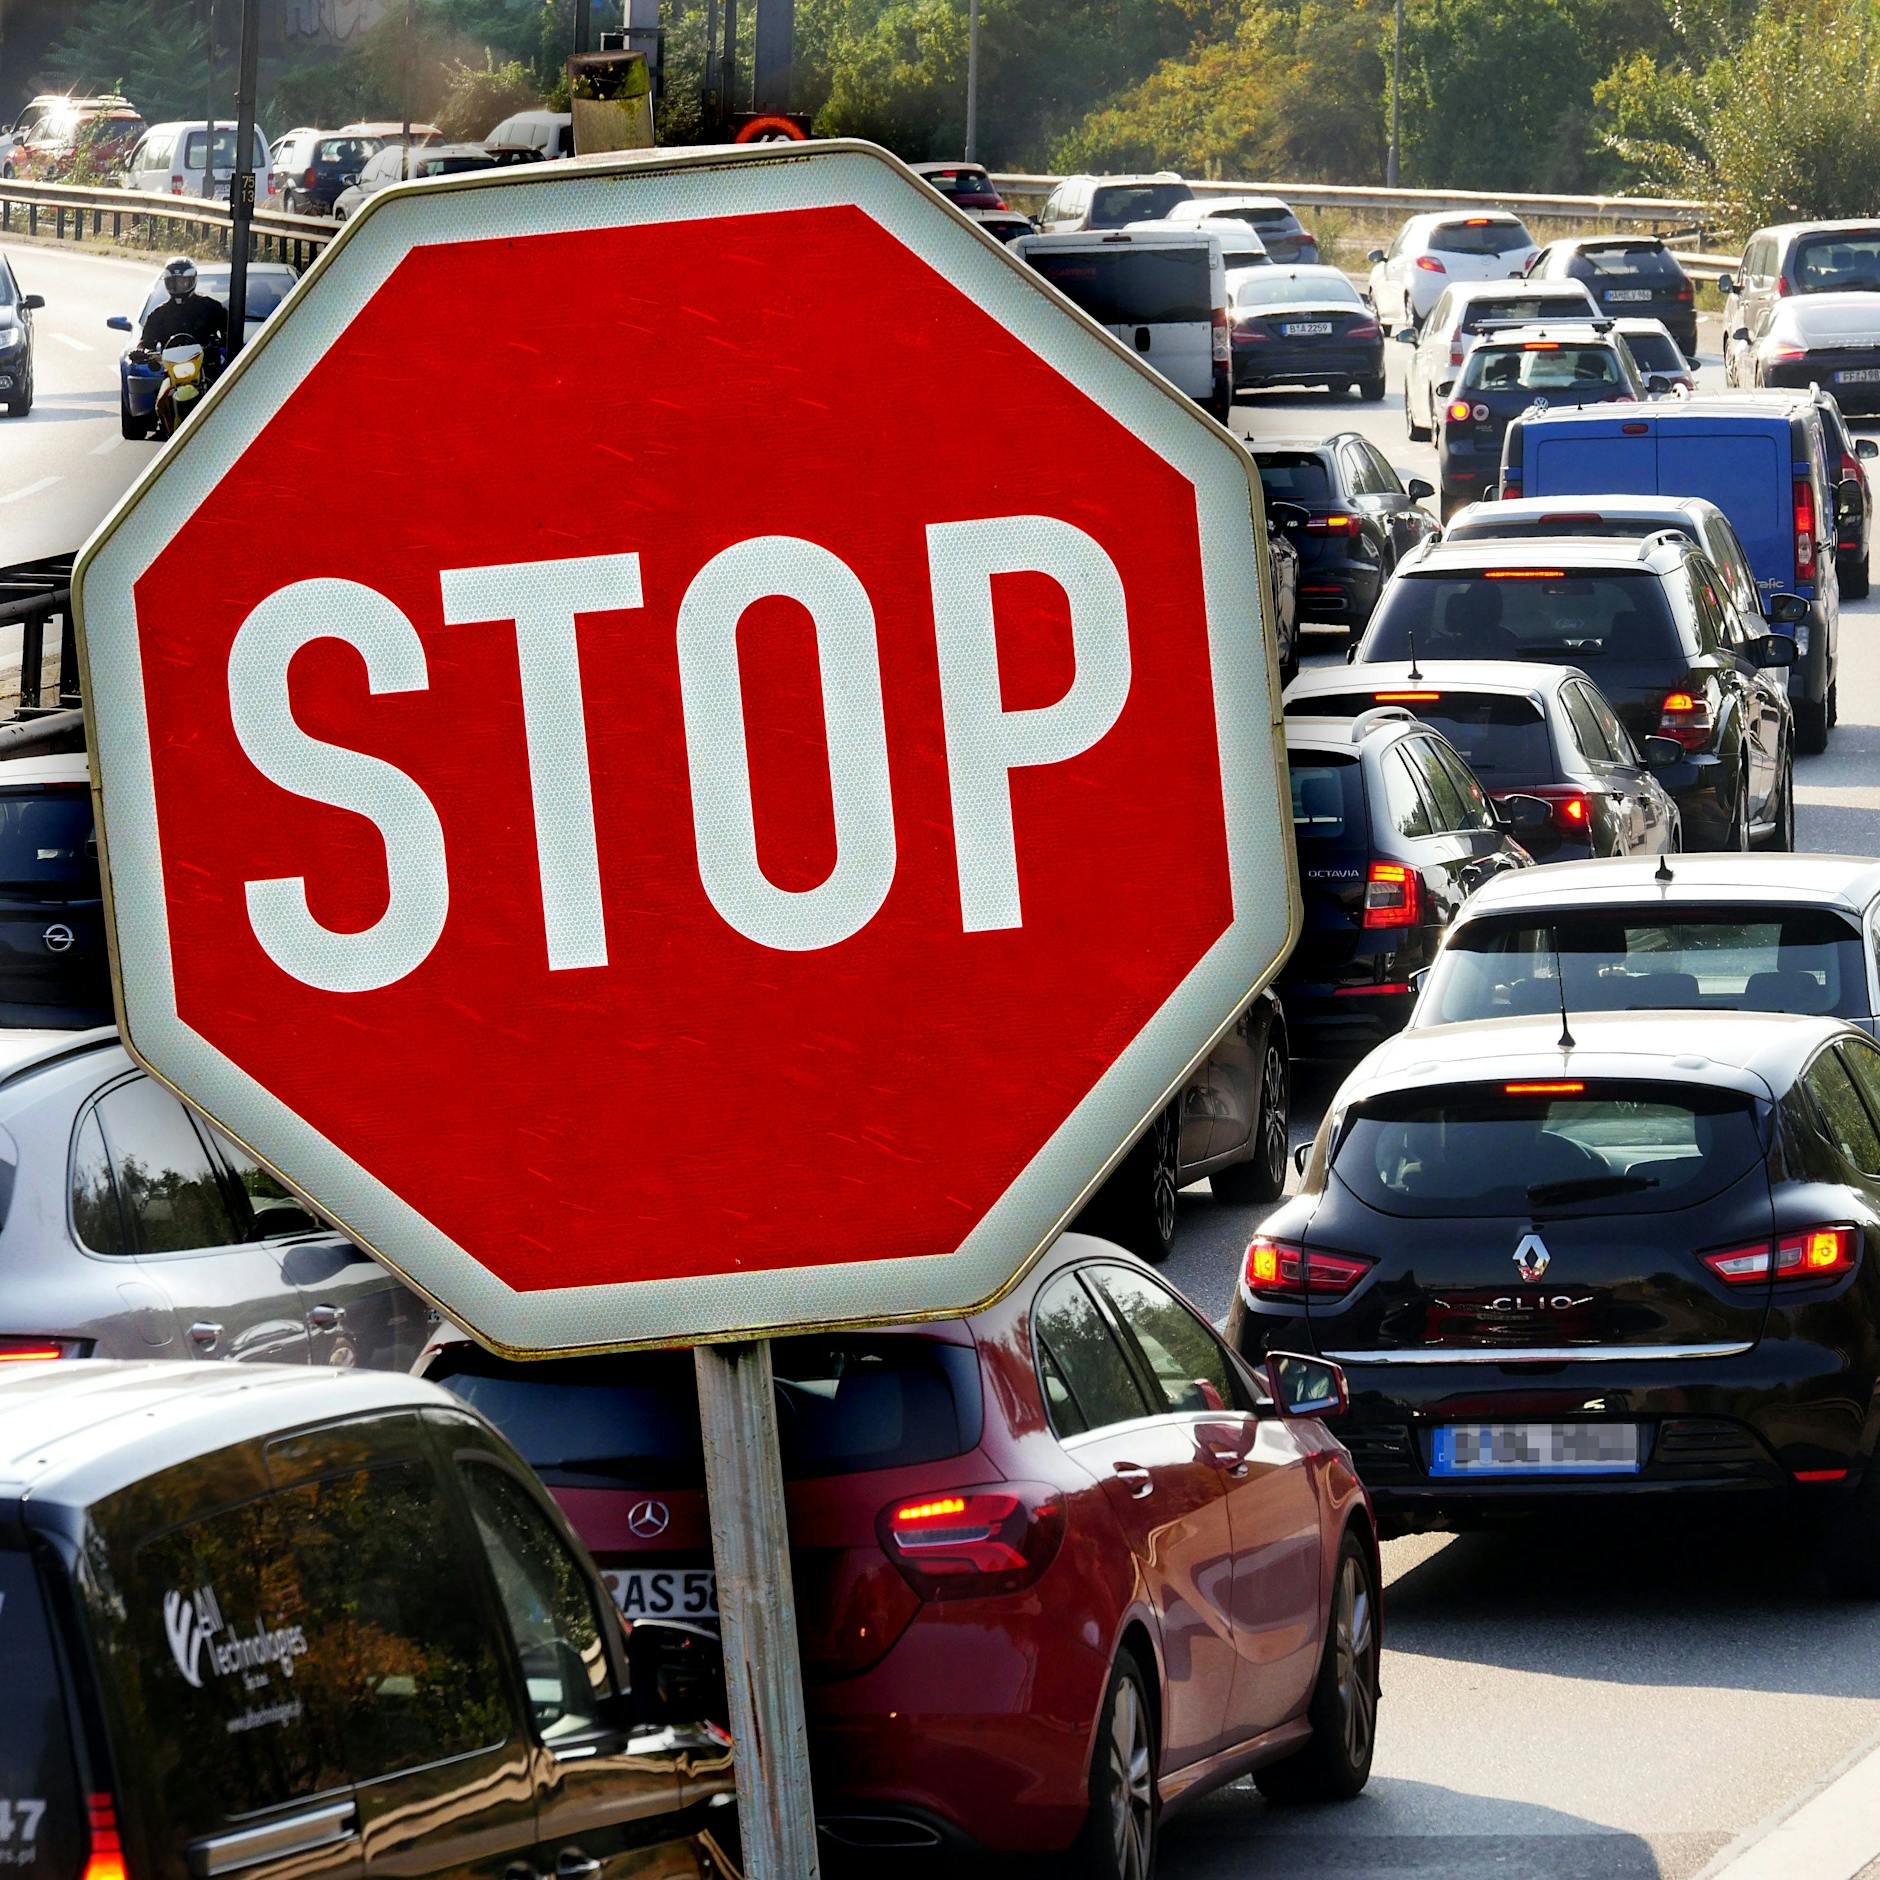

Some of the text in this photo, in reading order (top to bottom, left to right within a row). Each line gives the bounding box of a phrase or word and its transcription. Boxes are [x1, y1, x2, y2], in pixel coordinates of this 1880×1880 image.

[242, 175, 255, 189] 75
[242, 190, 255, 203] 13
[1755, 577, 1785, 589] rafic
[227, 514, 1132, 993] STOP
[1308, 870, 1360, 878] OCTAVIA
[1492, 1296, 1572, 1311] CLIO
[623, 1574, 674, 1613] AS
